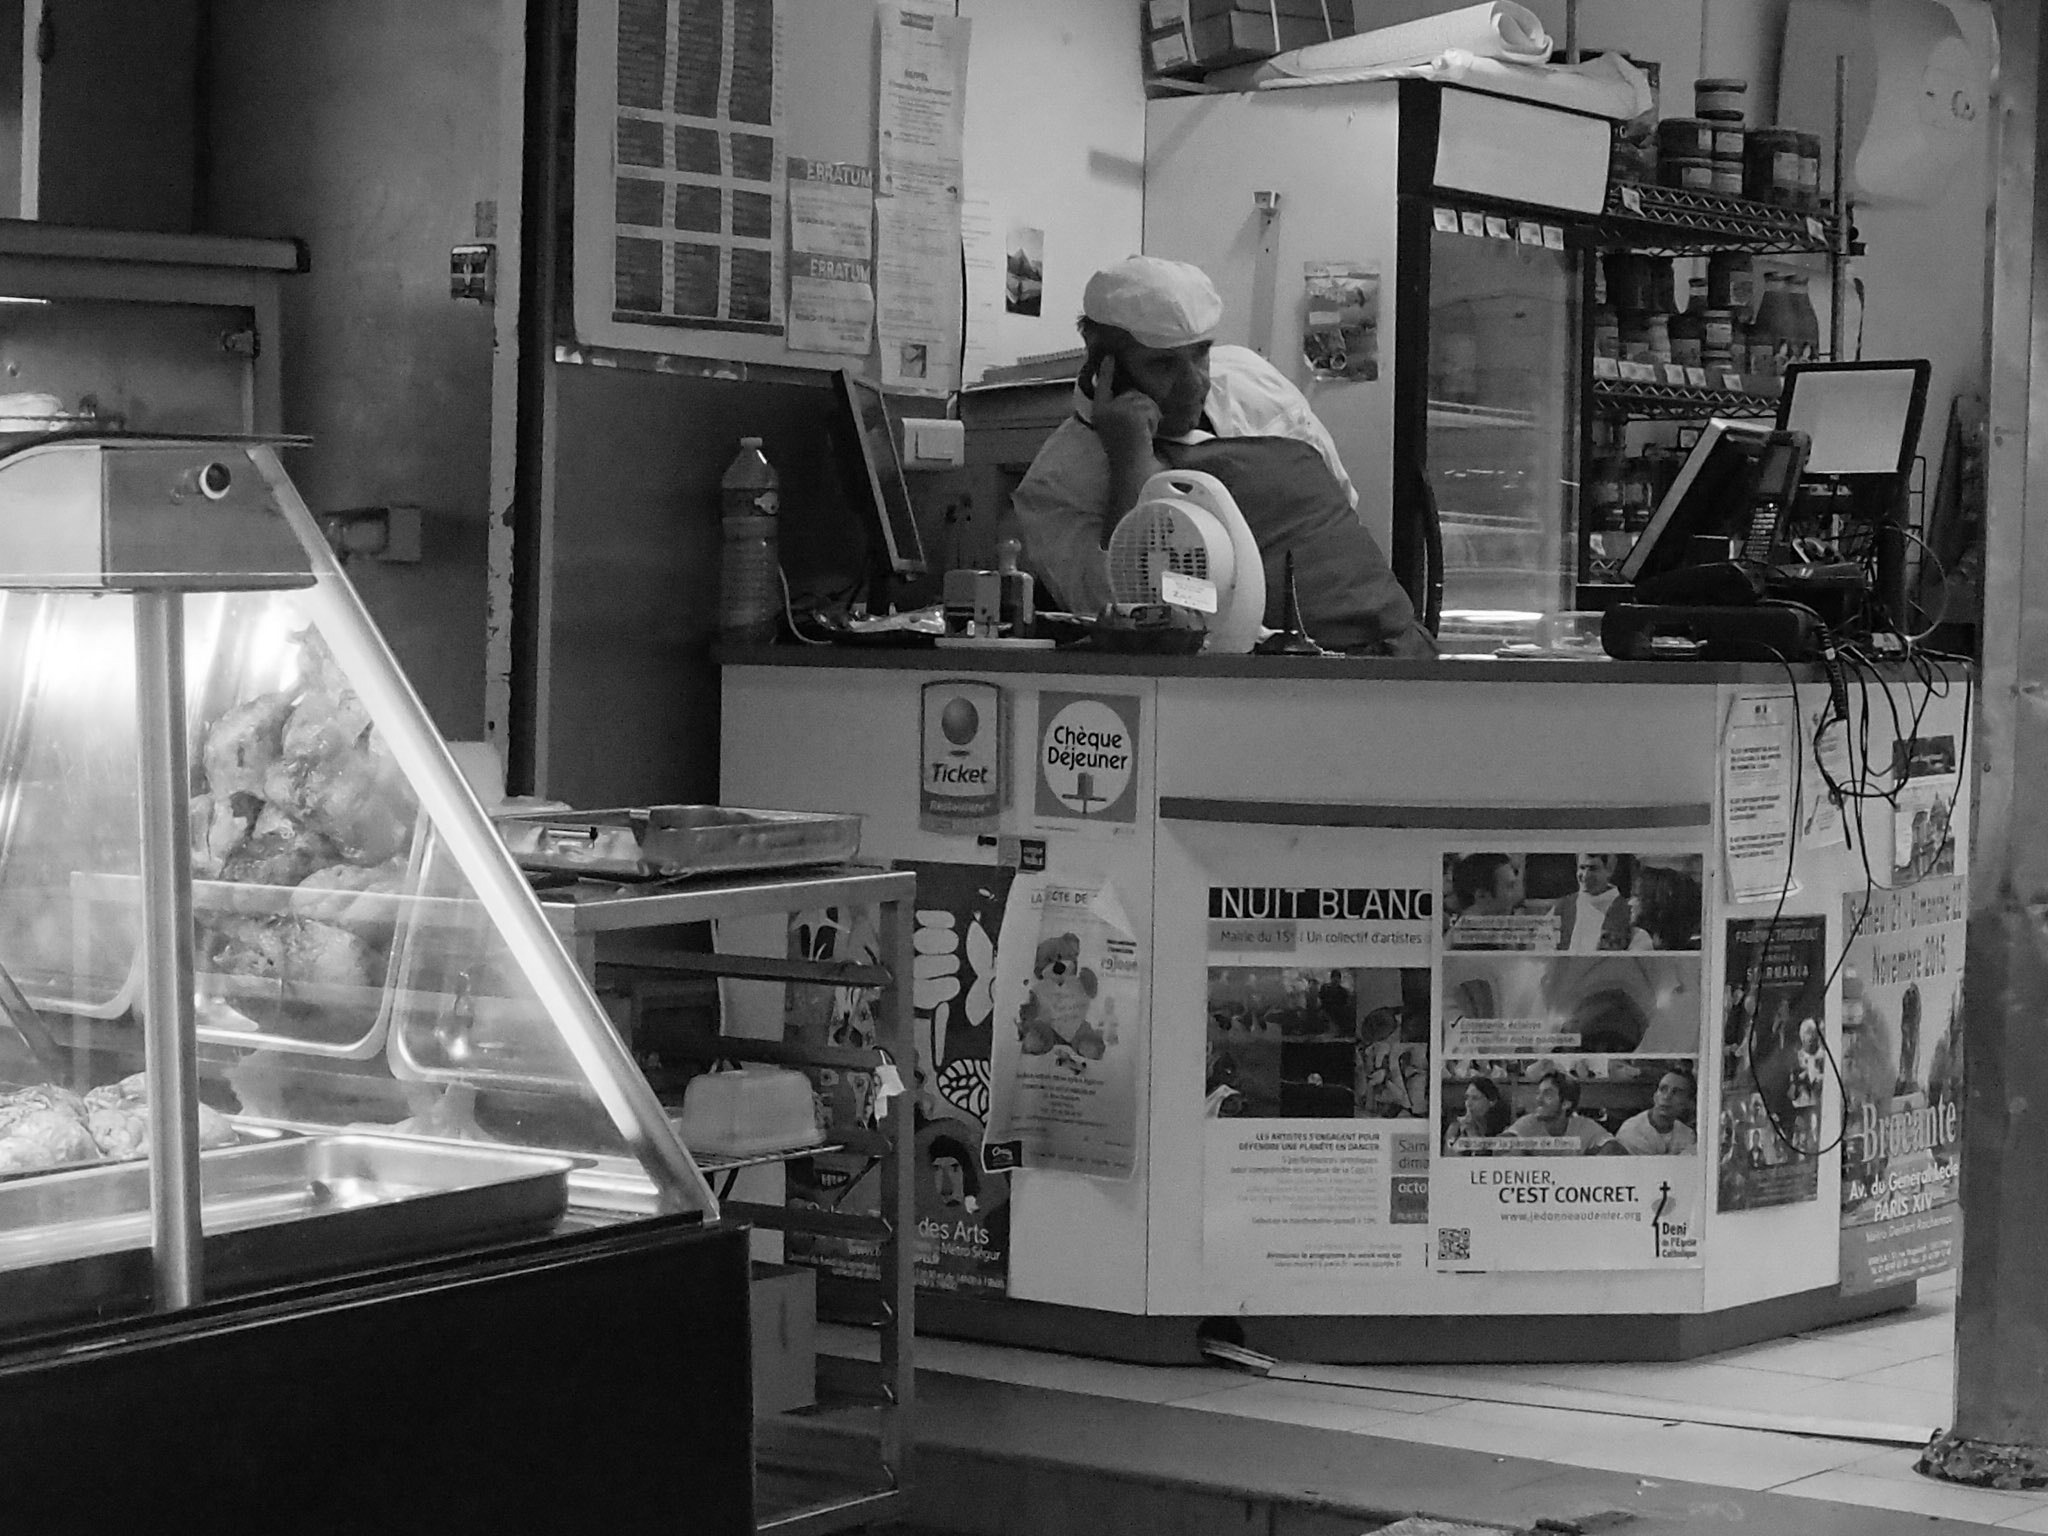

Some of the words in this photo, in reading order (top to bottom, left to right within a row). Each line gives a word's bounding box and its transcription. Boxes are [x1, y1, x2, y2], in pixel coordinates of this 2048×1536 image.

[806, 162, 873, 187] ERRATUM
[809, 259, 871, 282] ERRATUM
[1053, 726, 1122, 749] Chèque
[1048, 745, 1128, 770] Déjeuner
[931, 763, 988, 784] Ticket
[1221, 887, 1306, 919] NUIT
[1220, 930, 1254, 943] Mairie
[1257, 930, 1273, 943] du
[1307, 931, 1323, 943] Un
[1325, 930, 1369, 944] collectif
[1861, 1094, 1957, 1163] Brocante
[1470, 1170, 1487, 1185] LE
[1492, 1170, 1556, 1186] DENIER,
[1850, 1180, 1868, 1201] Av.
[1871, 1173, 1886, 1196] du
[1499, 1186, 1550, 1204] C'EST
[1554, 1186, 1640, 1203] CONCRET.
[1874, 1197, 1910, 1222] PARIS
[917, 1217, 950, 1240] des
[953, 1220, 990, 1244] Arts
